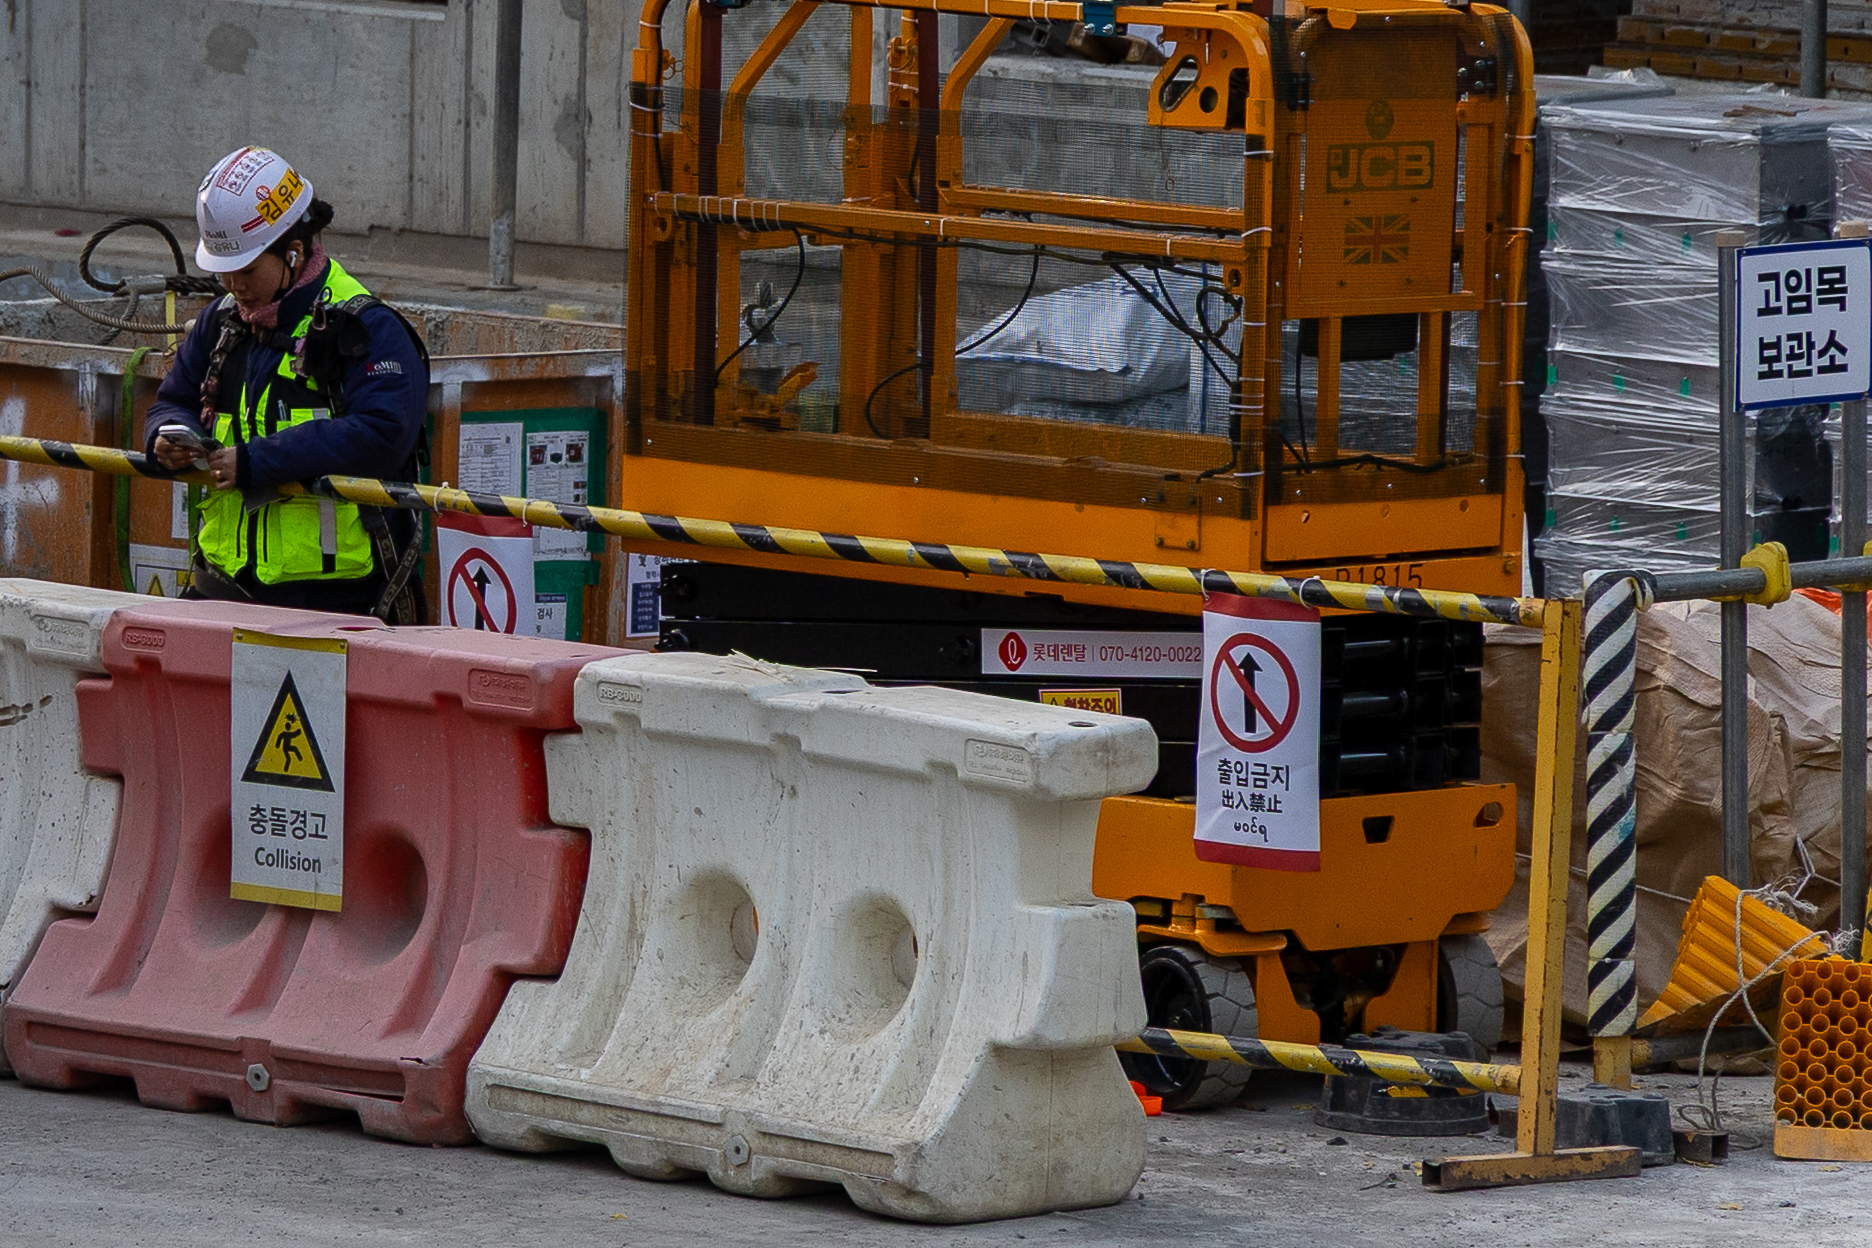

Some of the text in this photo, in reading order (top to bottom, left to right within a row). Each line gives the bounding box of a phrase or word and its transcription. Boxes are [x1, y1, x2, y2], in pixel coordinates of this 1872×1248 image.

[1329, 145, 1430, 188] JCB
[1757, 265, 1849, 317] 고임목
[1757, 329, 1849, 380] 보관소
[1033, 643, 1203, 663] 롯데렌탈 070-4120-0022
[1217, 757, 1290, 792] 출입금지
[1221, 788, 1284, 814] 出入禁止
[248, 803, 328, 840] 충돌경고
[254, 846, 322, 873] Collision
